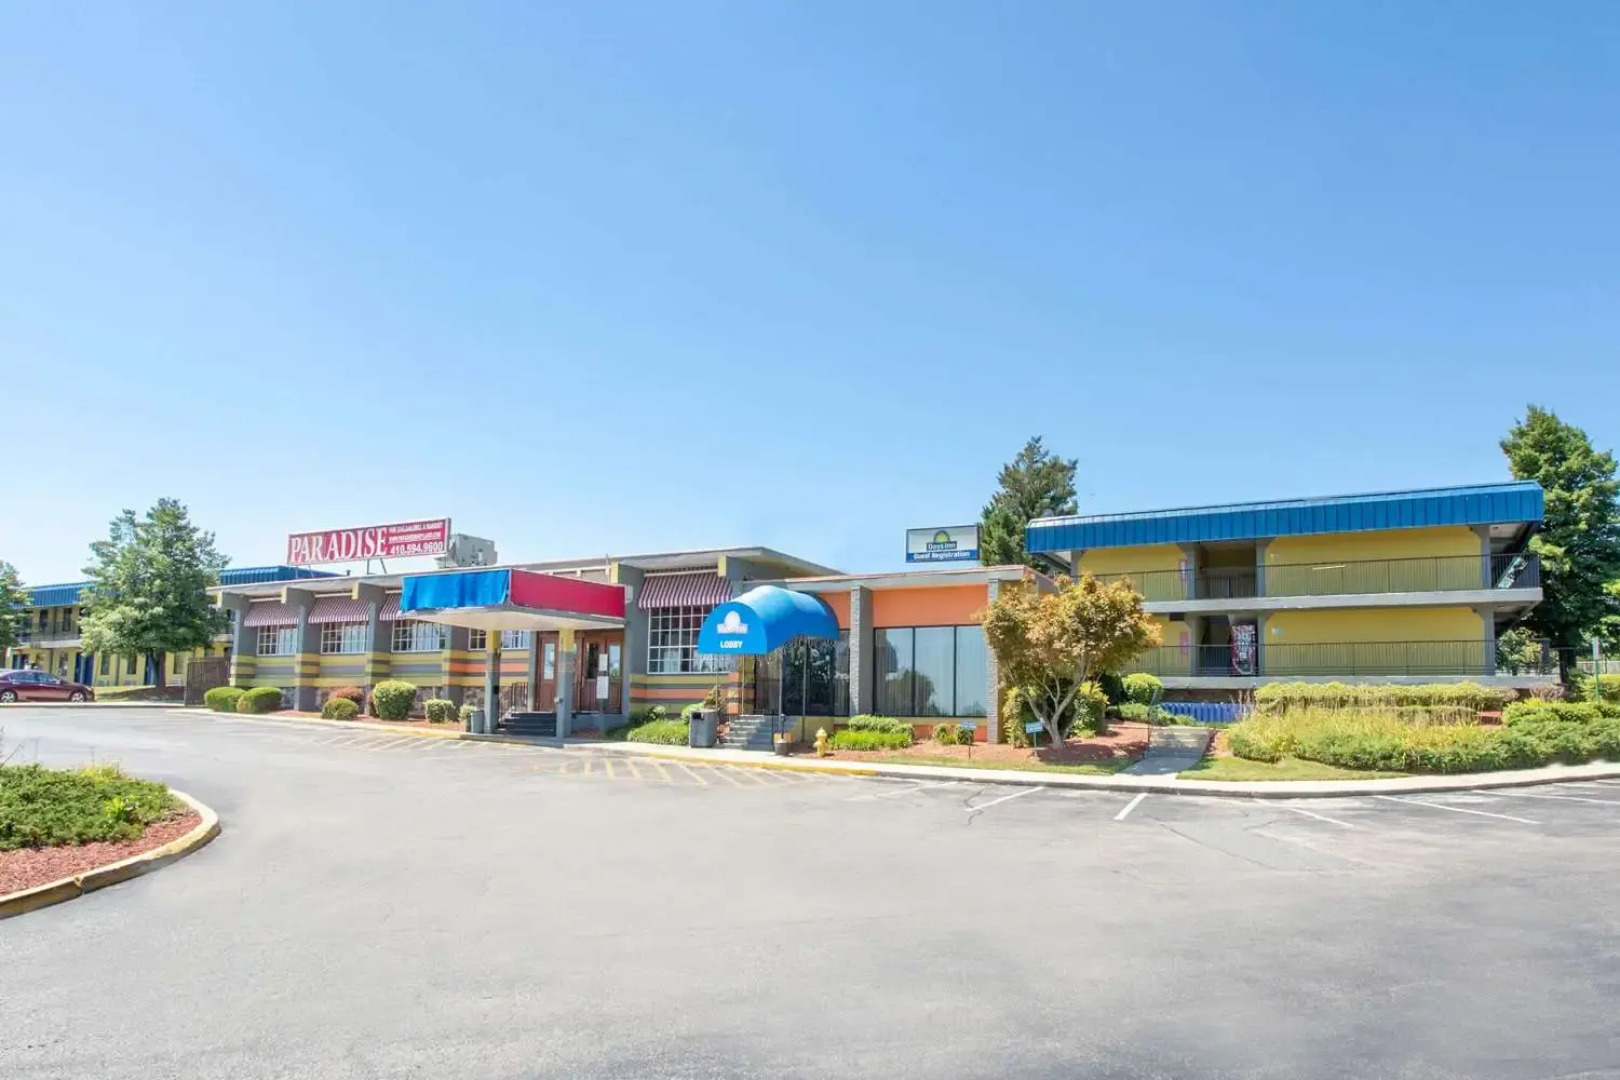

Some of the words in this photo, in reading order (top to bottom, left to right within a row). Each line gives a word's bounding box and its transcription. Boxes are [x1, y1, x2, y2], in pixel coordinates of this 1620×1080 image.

[290, 527, 388, 563] PARADISE
[932, 551, 970, 560] Registration
[719, 640, 743, 649] LOBBY
